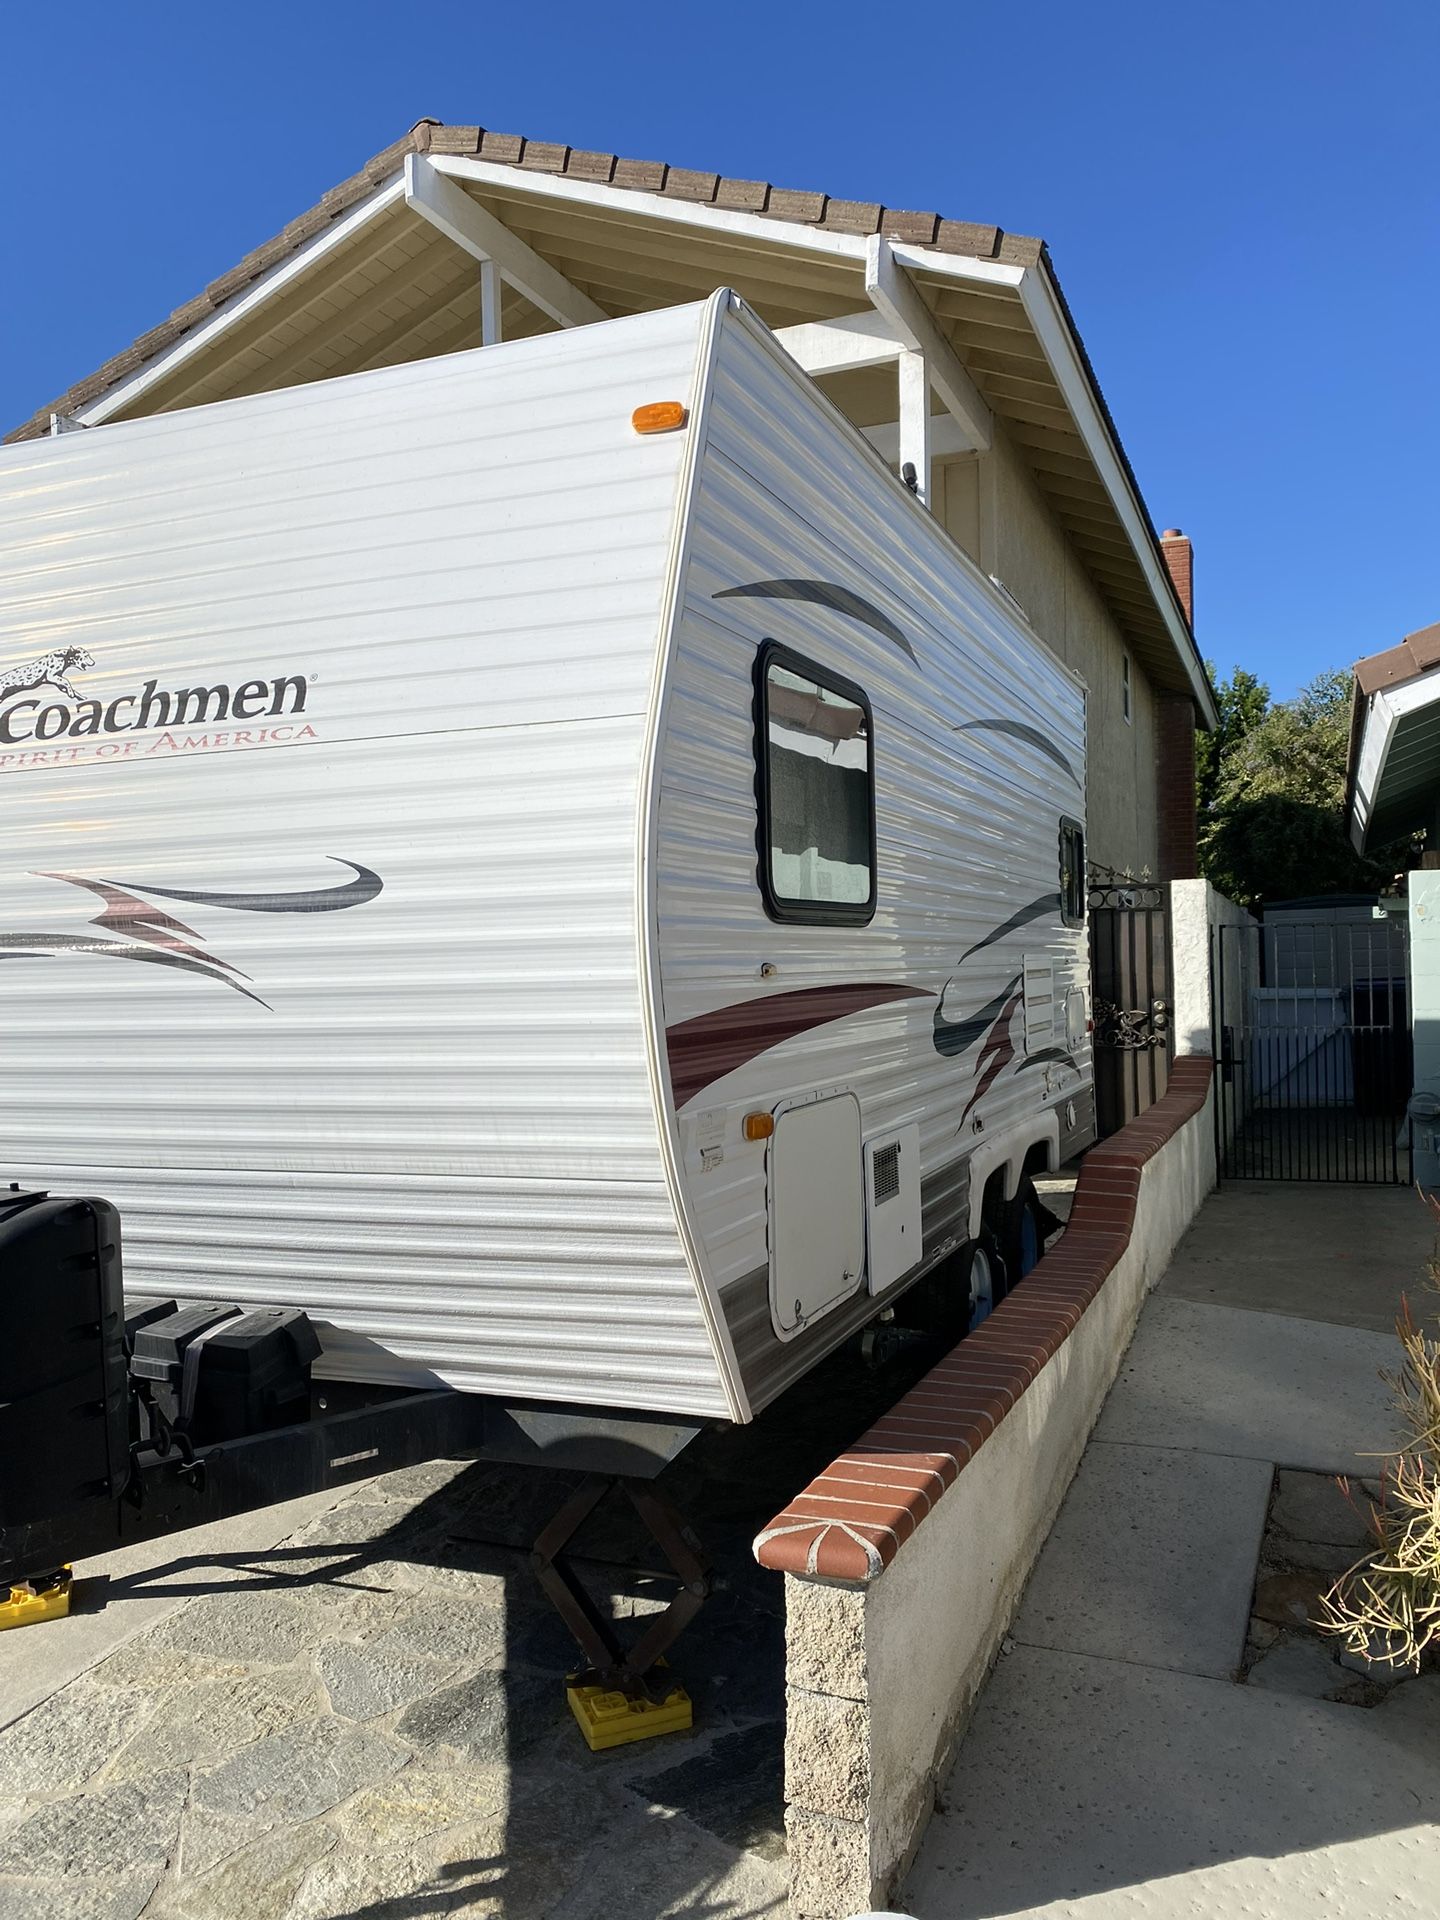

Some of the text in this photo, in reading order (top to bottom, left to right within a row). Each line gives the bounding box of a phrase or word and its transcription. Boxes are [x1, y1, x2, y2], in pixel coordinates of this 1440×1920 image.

[0, 724, 319, 767] PIRIT OF AMERICA
